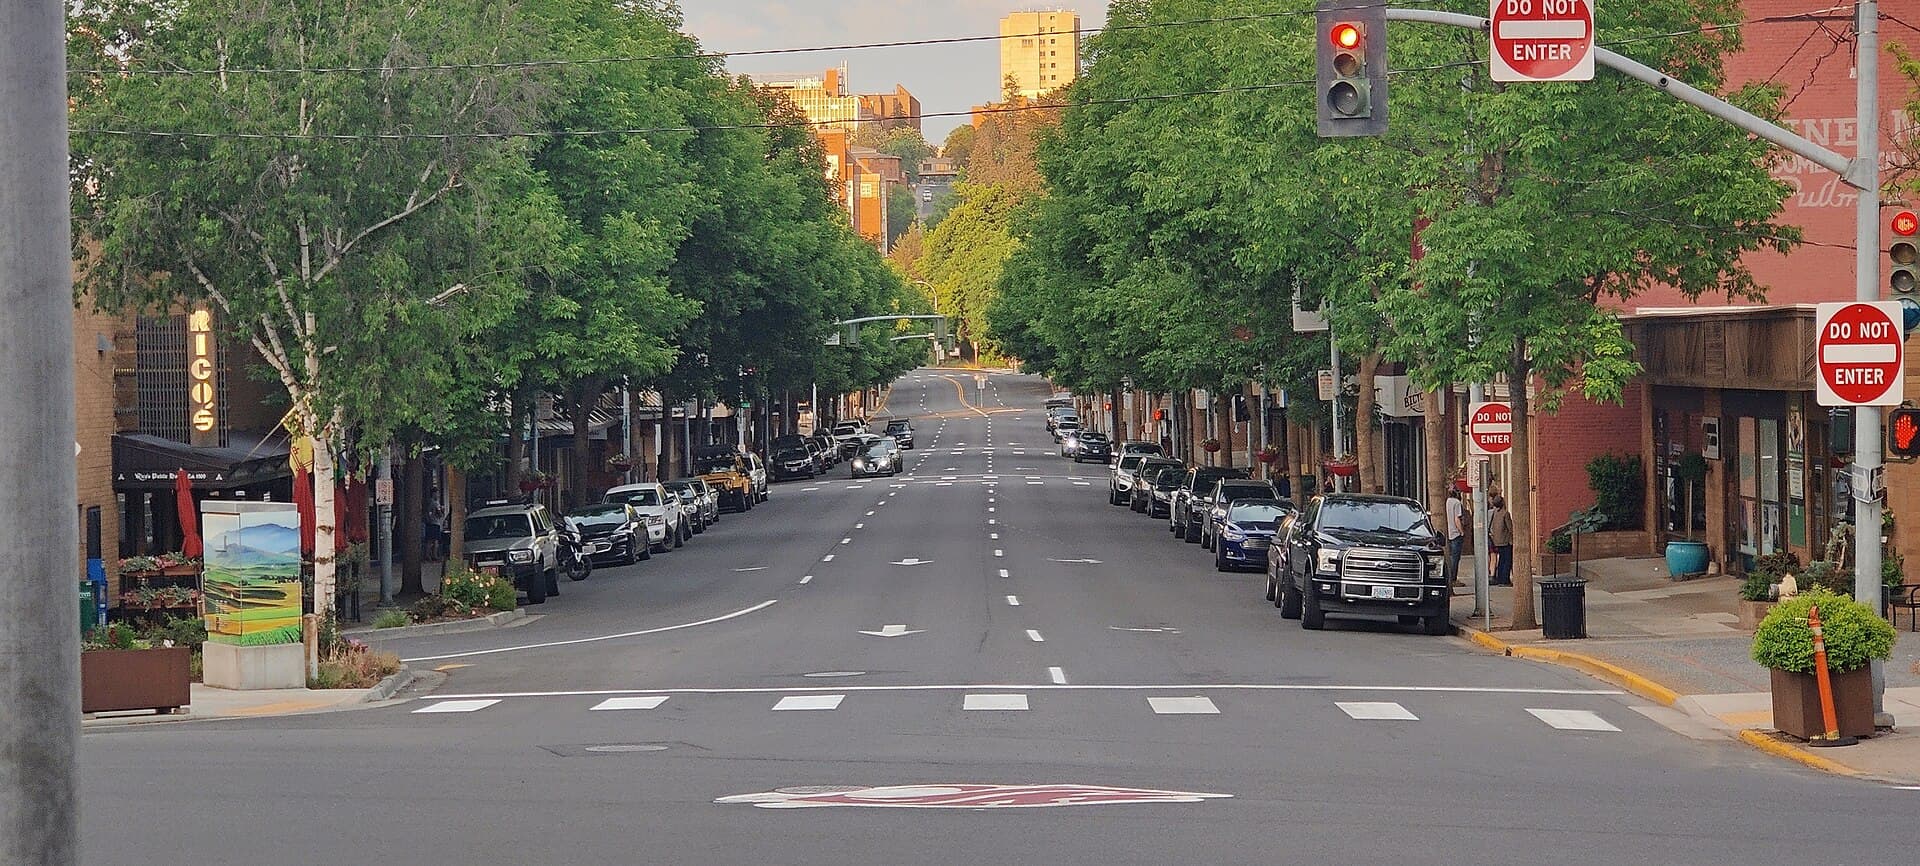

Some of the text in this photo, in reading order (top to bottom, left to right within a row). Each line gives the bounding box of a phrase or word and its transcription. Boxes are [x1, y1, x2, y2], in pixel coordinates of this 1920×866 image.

[1506, 0, 1578, 15] DO NOT
[1513, 44, 1571, 60] ENTER
[1830, 322, 1890, 339] DO NOT
[190, 310, 215, 431] RICO'S
[1835, 368, 1884, 385] ENTER
[1477, 412, 1511, 422] DO NOT
[1480, 434, 1510, 444] ENTER
